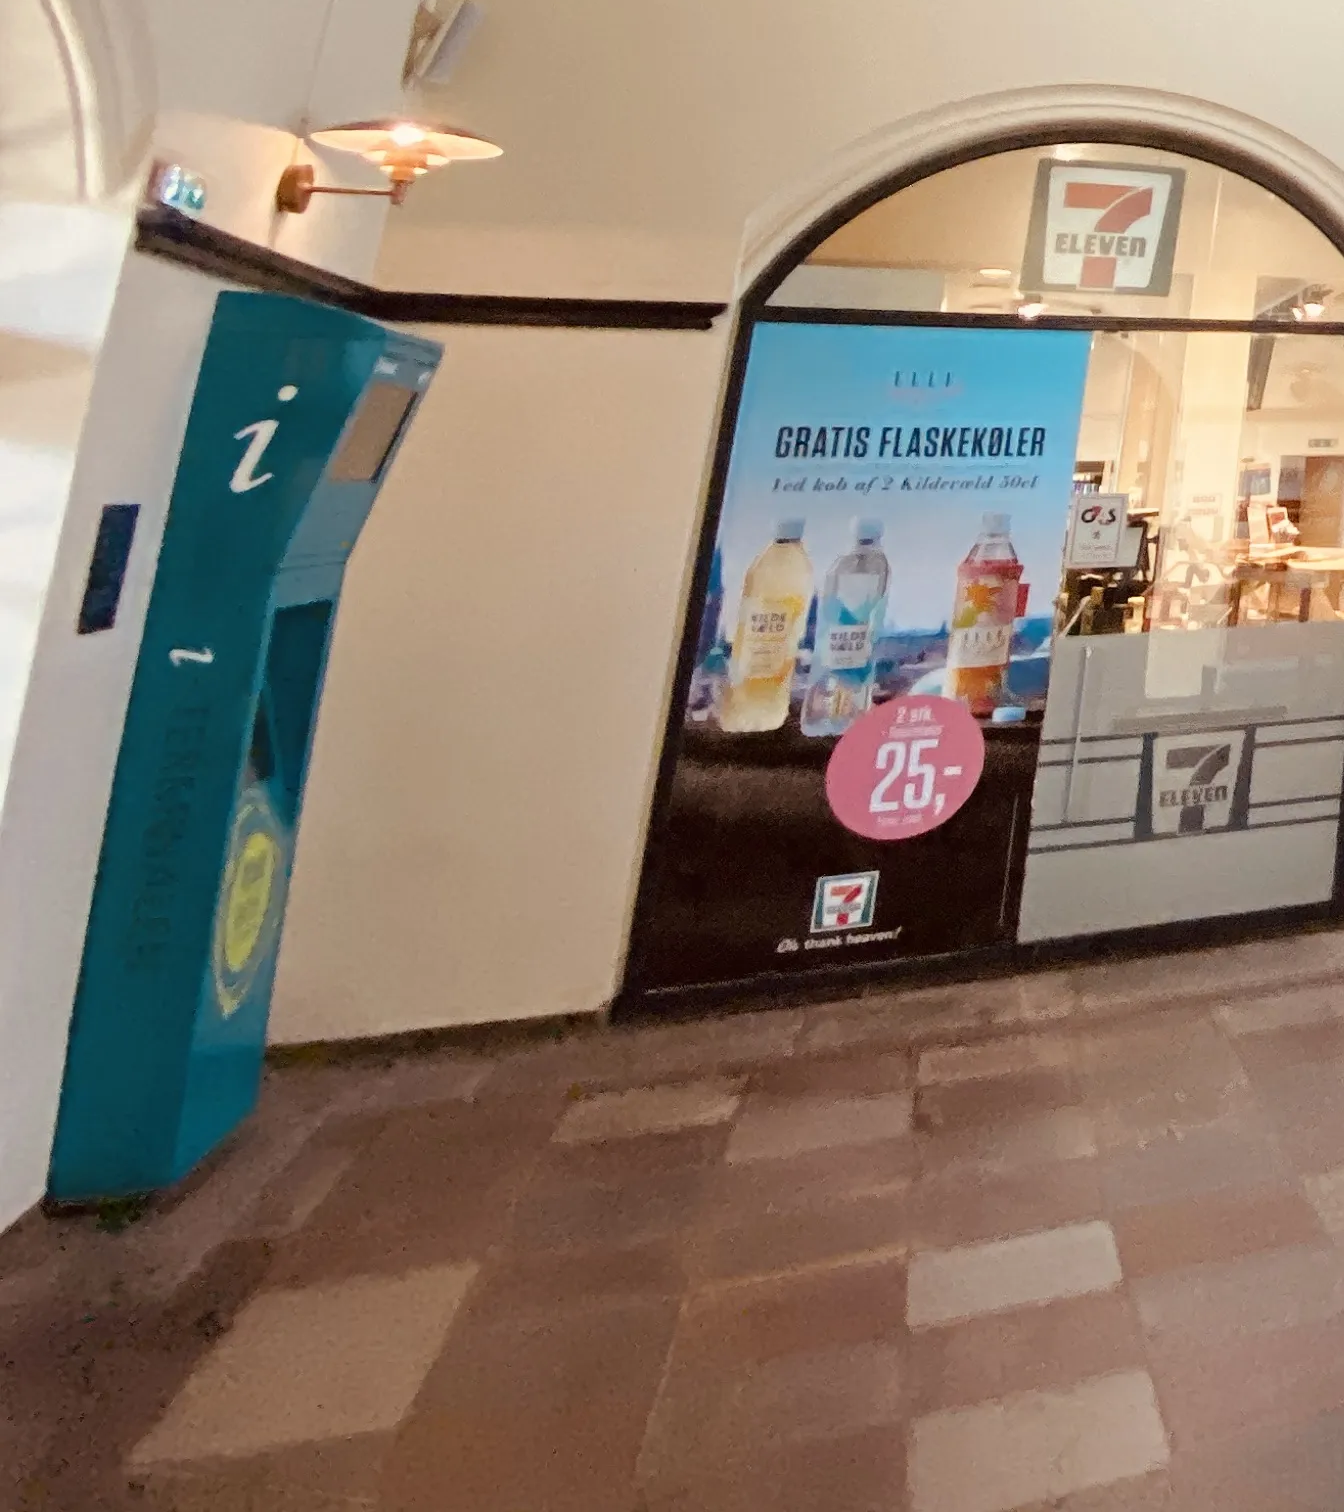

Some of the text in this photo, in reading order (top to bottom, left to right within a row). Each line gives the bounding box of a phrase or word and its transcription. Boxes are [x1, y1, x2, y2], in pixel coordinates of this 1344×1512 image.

[1055, 233, 1147, 258] ELEVEN
[1064, 182, 1154, 288] 7
[775, 426, 1046, 458] GRATIS FLASKEKØLER
[869, 738, 963, 816] 25,-
[1166, 744, 1231, 834] 7
